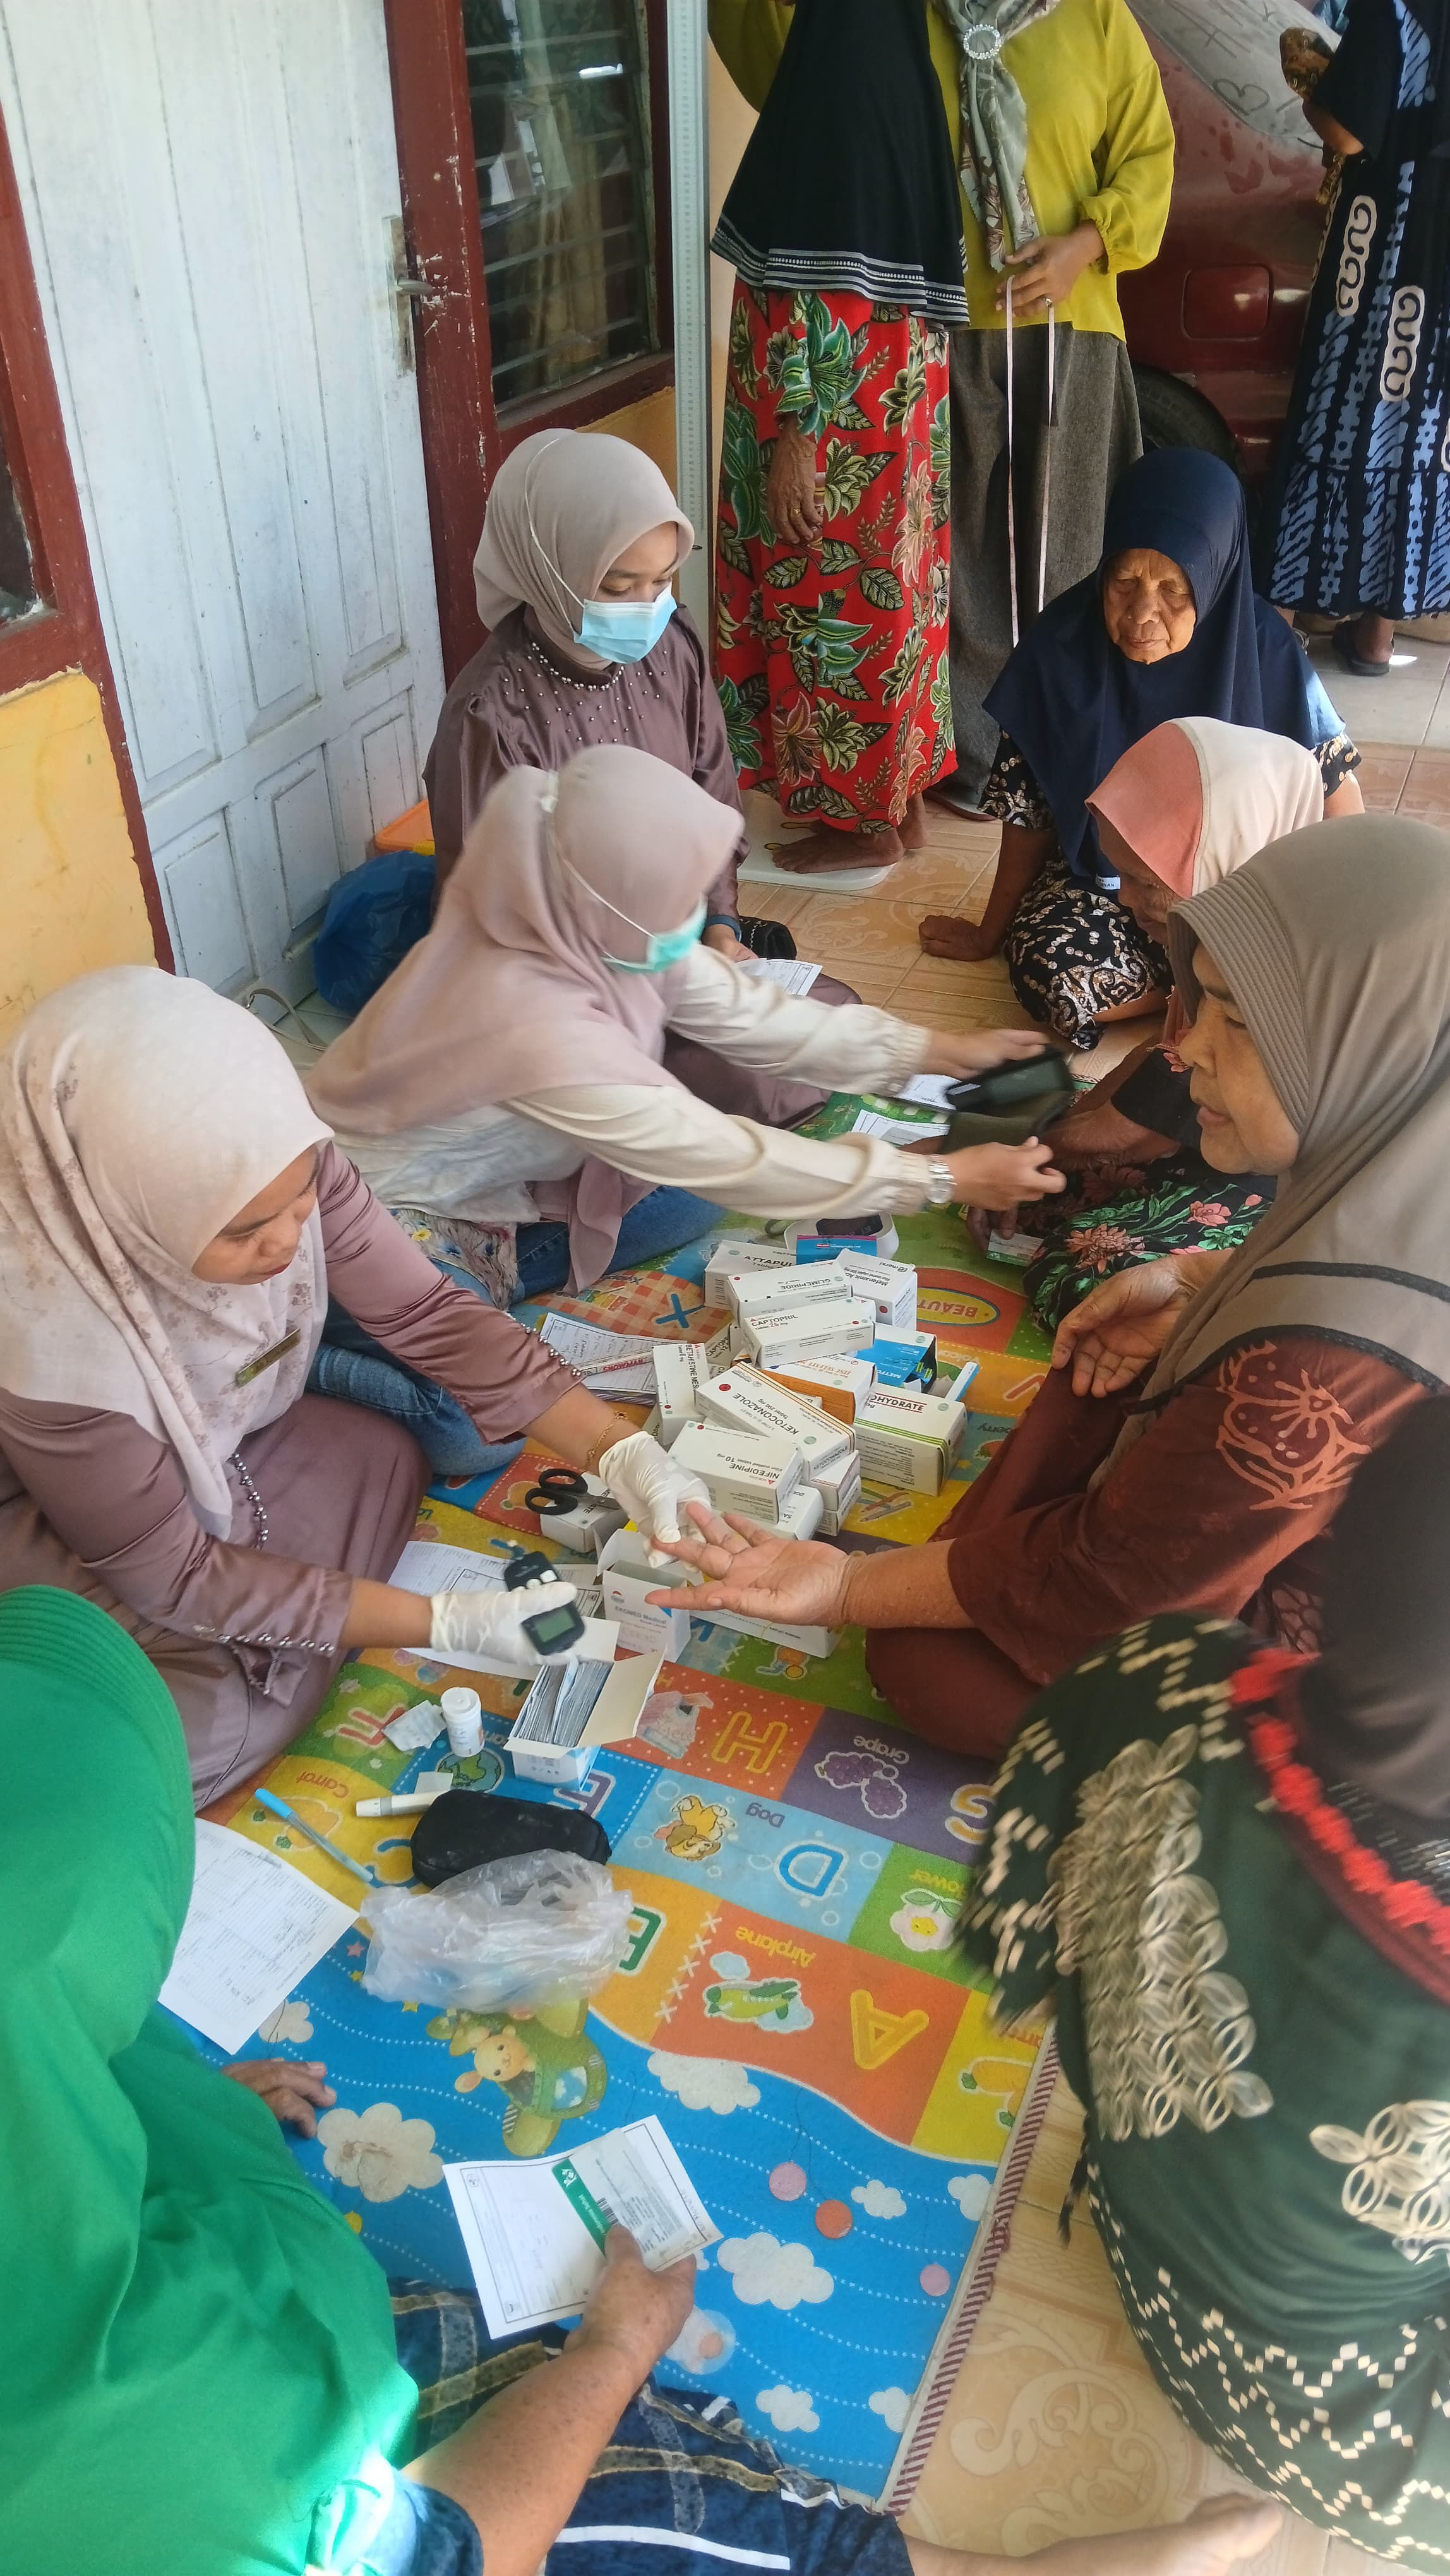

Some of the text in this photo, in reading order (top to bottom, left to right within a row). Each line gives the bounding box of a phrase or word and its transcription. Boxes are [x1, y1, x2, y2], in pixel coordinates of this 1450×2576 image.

[781, 1278, 831, 1291] GLIMEPIRIDE
[752, 1314, 799, 1327] CAPTOPRIL
[685, 1344, 698, 1377] BETAHISTINE
[732, 1392, 800, 1435] KETOCONAZOLE
[725, 1455, 736, 1463] 10
[729, 1463, 780, 1479] NIFEDIPINE
[711, 1710, 788, 1775] H
[853, 1734, 910, 1765] Grape
[296, 1771, 349, 1799] Carrot
[745, 1803, 785, 1828] Dog
[777, 1842, 846, 1898] D
[735, 1924, 816, 1968] Airplane
[850, 1989, 930, 2070] A
